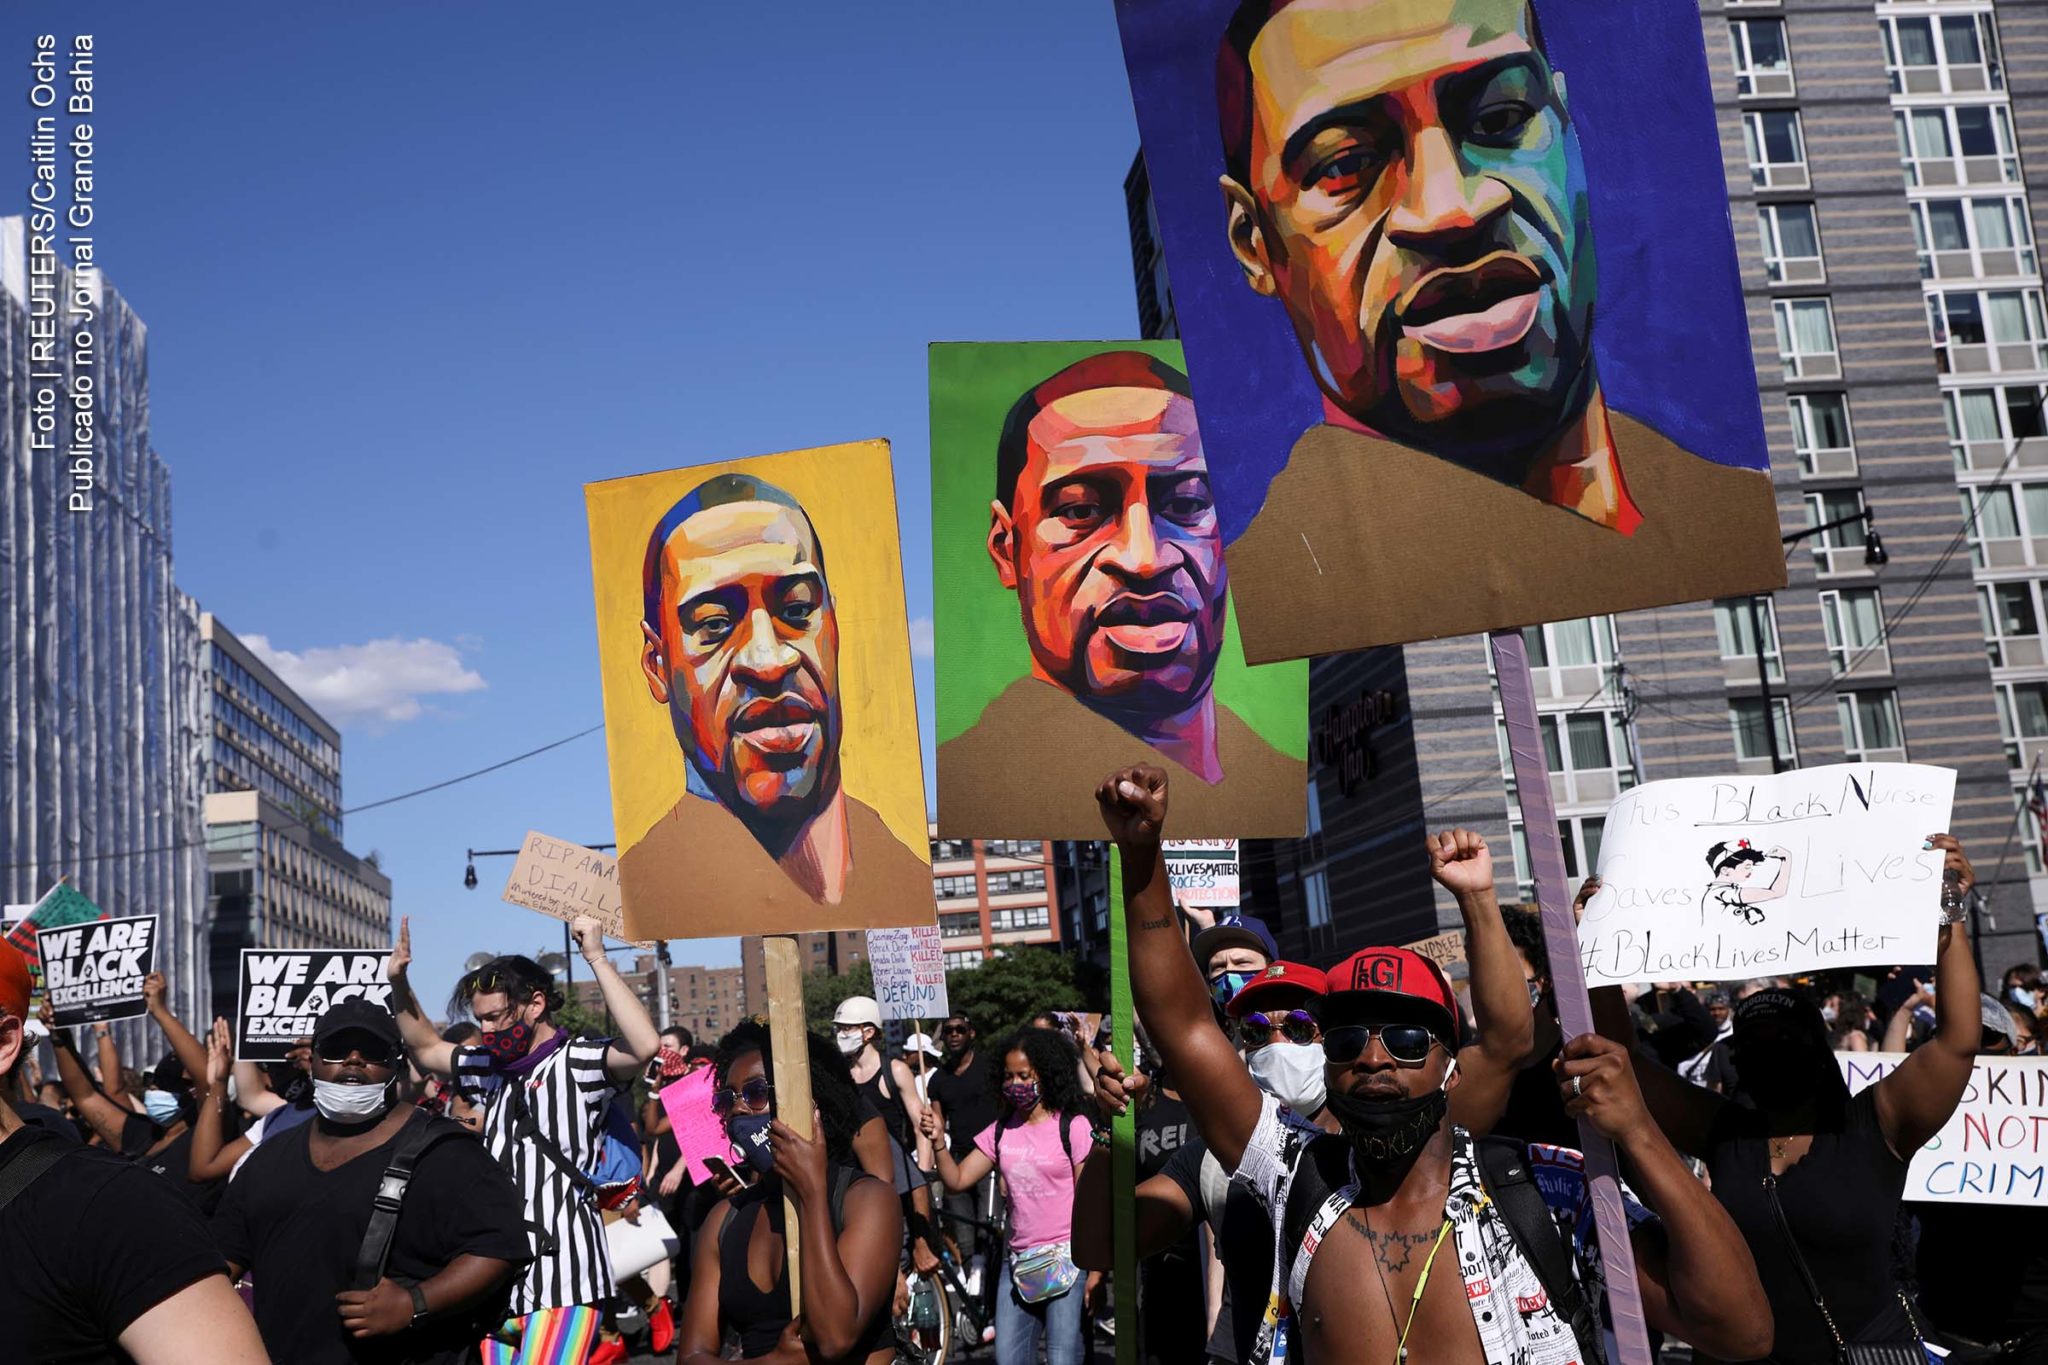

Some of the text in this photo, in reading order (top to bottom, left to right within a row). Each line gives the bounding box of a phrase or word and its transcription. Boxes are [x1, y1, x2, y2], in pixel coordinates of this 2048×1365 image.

[1610, 790, 1680, 836] This
[1839, 770, 1935, 815] Nurse
[529, 837, 574, 863] RIP
[1166, 862, 1239, 877] KLIVESMATTER
[1587, 836, 1933, 922] Saves Lives
[41, 920, 153, 961] WE ARE
[911, 926, 939, 939] KILLED
[47, 947, 149, 989] BLACK
[247, 955, 311, 985] WE
[911, 950, 943, 962] KILLED
[51, 975, 145, 1006] EXCELLENCE
[882, 981, 936, 1003] DEFUND
[914, 973, 943, 985] KILLED
[245, 984, 393, 1016] BLACK
[892, 1004, 926, 1019] NYPD
[1847, 1060, 1896, 1091] M
[1346, 1102, 1435, 1161] OOKLYN
